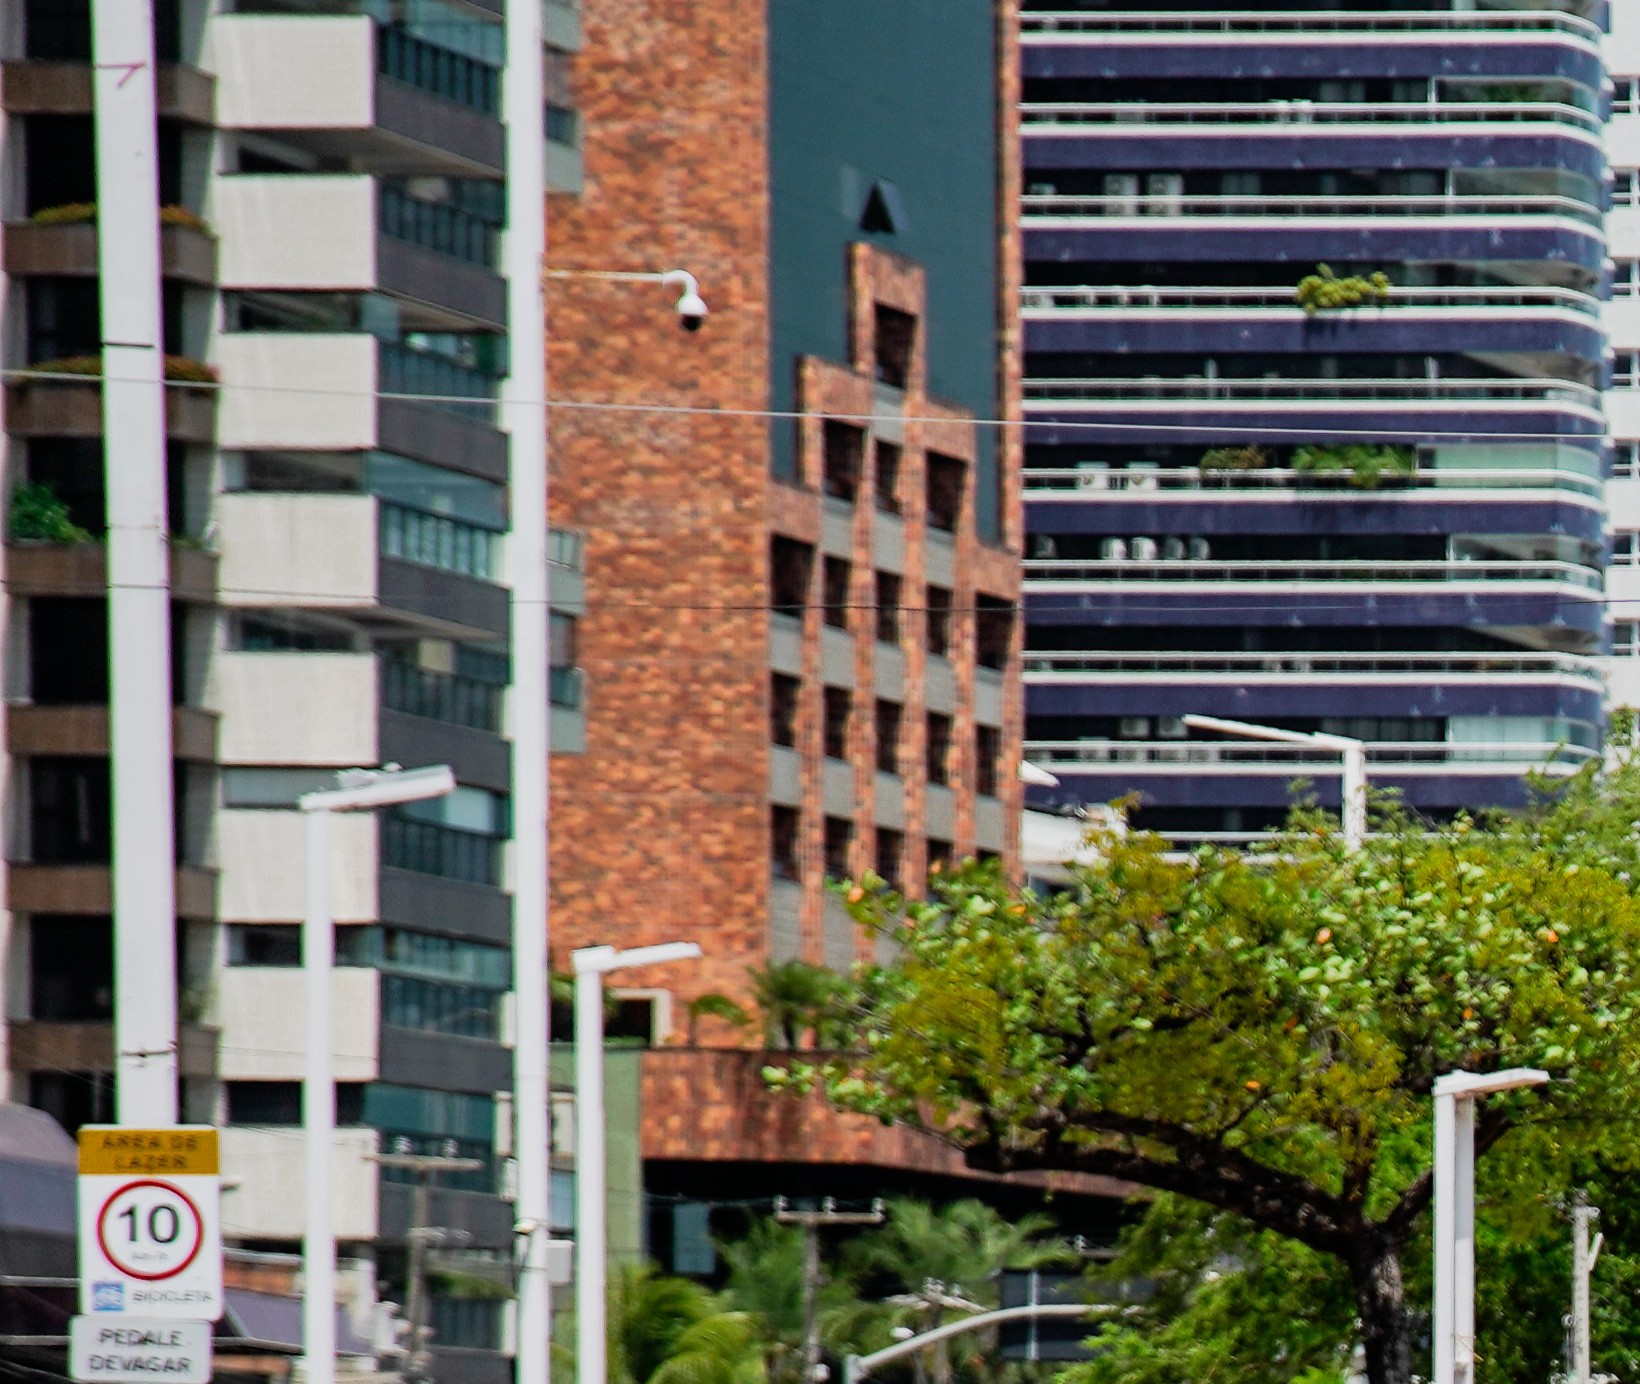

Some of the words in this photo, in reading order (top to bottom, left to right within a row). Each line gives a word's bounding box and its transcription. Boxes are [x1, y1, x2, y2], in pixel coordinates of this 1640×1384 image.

[170, 1135, 199, 1150] DE
[114, 1155, 187, 1169] LAZER
[118, 1203, 181, 1244] 10
[131, 1289, 213, 1304] BICICLETA
[98, 1327, 183, 1348] PEDALE
[89, 1353, 192, 1374] DEVAGAR
